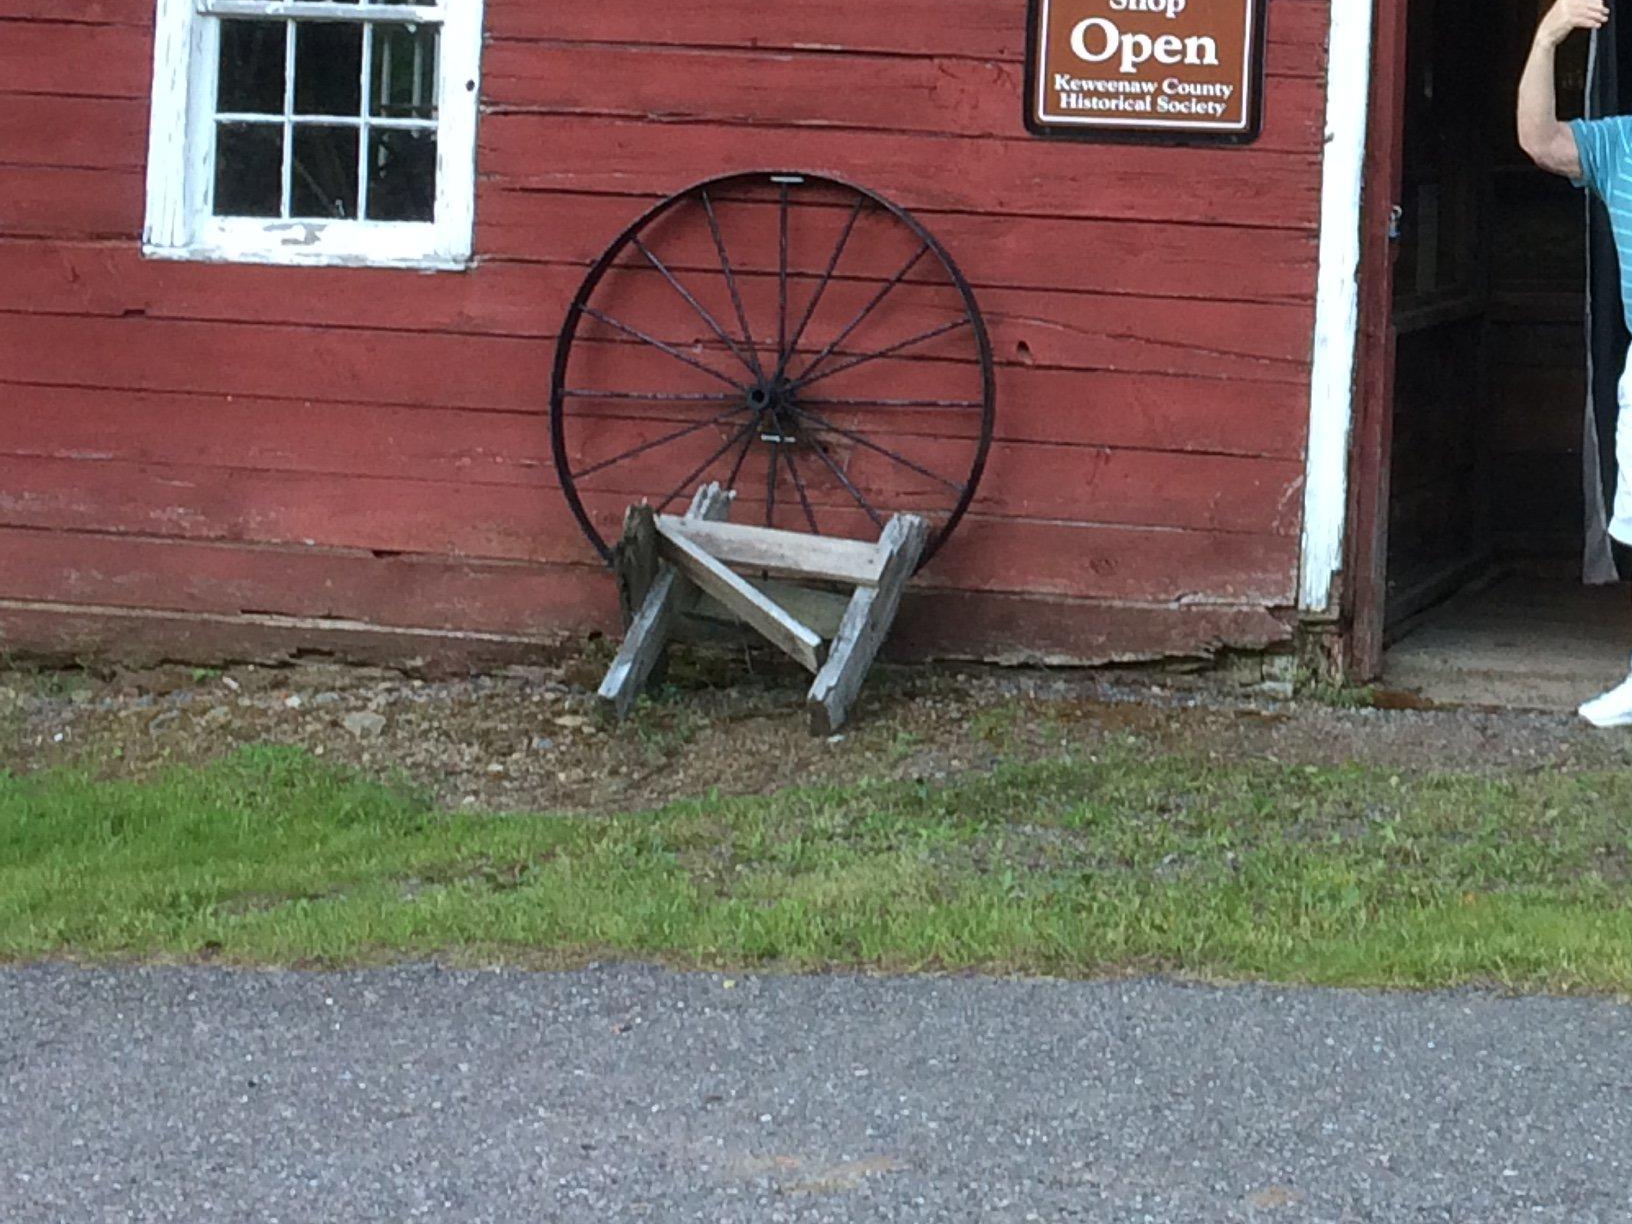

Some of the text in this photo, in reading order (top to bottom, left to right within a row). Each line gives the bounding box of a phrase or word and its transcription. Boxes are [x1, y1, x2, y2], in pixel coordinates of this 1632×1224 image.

[1070, 17, 1219, 74] Open
[1054, 73, 1233, 100] Keweenaw County
[1059, 92, 1227, 118] Historical Society
